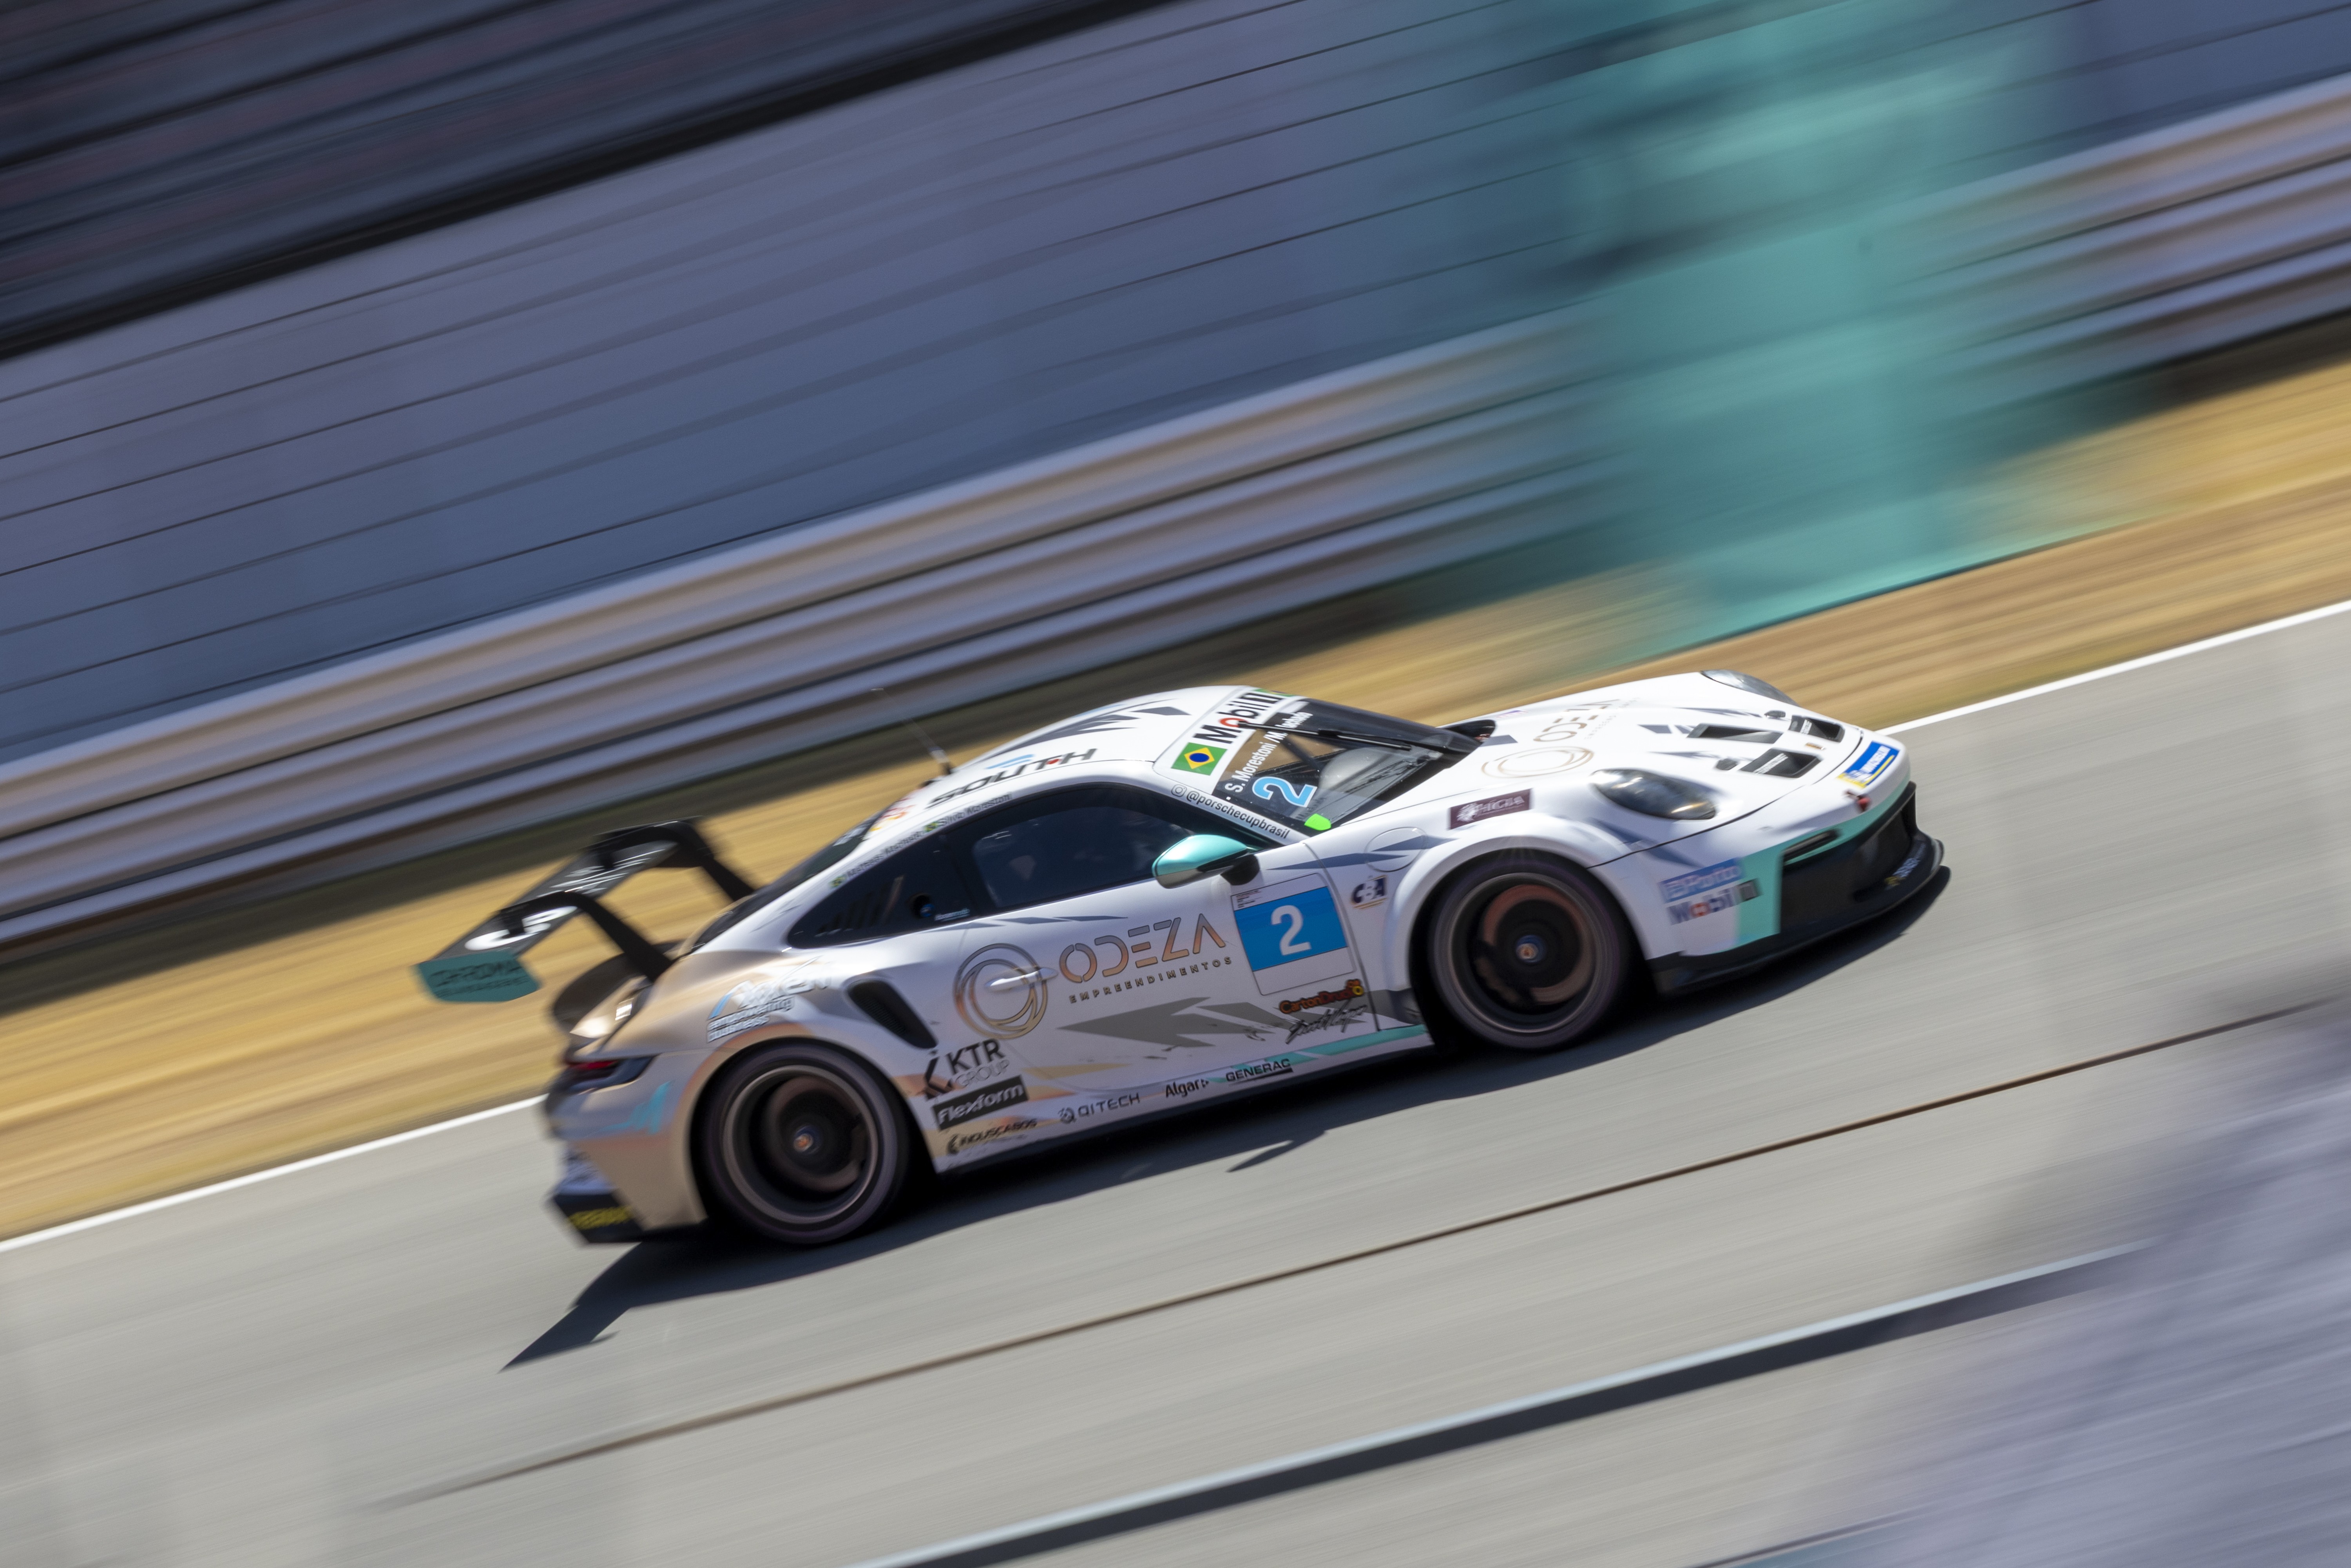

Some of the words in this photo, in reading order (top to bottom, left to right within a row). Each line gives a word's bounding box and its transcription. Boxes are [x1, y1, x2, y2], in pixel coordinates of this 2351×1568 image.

[1192, 701, 1272, 744] Mobil
[1275, 712, 1313, 729] achado
[1231, 742, 1277, 782] Morestoni
[1224, 782, 1246, 793] S.
[1252, 776, 1318, 808] 2
[1186, 791, 1290, 838] @porschecupbrasil
[1059, 913, 1226, 983] ODEZA
[1270, 905, 1312, 956] 2
[1069, 956, 1232, 1003] EMPREENDIMENTOS
[945, 1039, 1006, 1075] KTR
[955, 1059, 1010, 1088] GROUP
[1226, 1058, 1291, 1082] GENERAC
[1165, 1079, 1200, 1097] Algar
